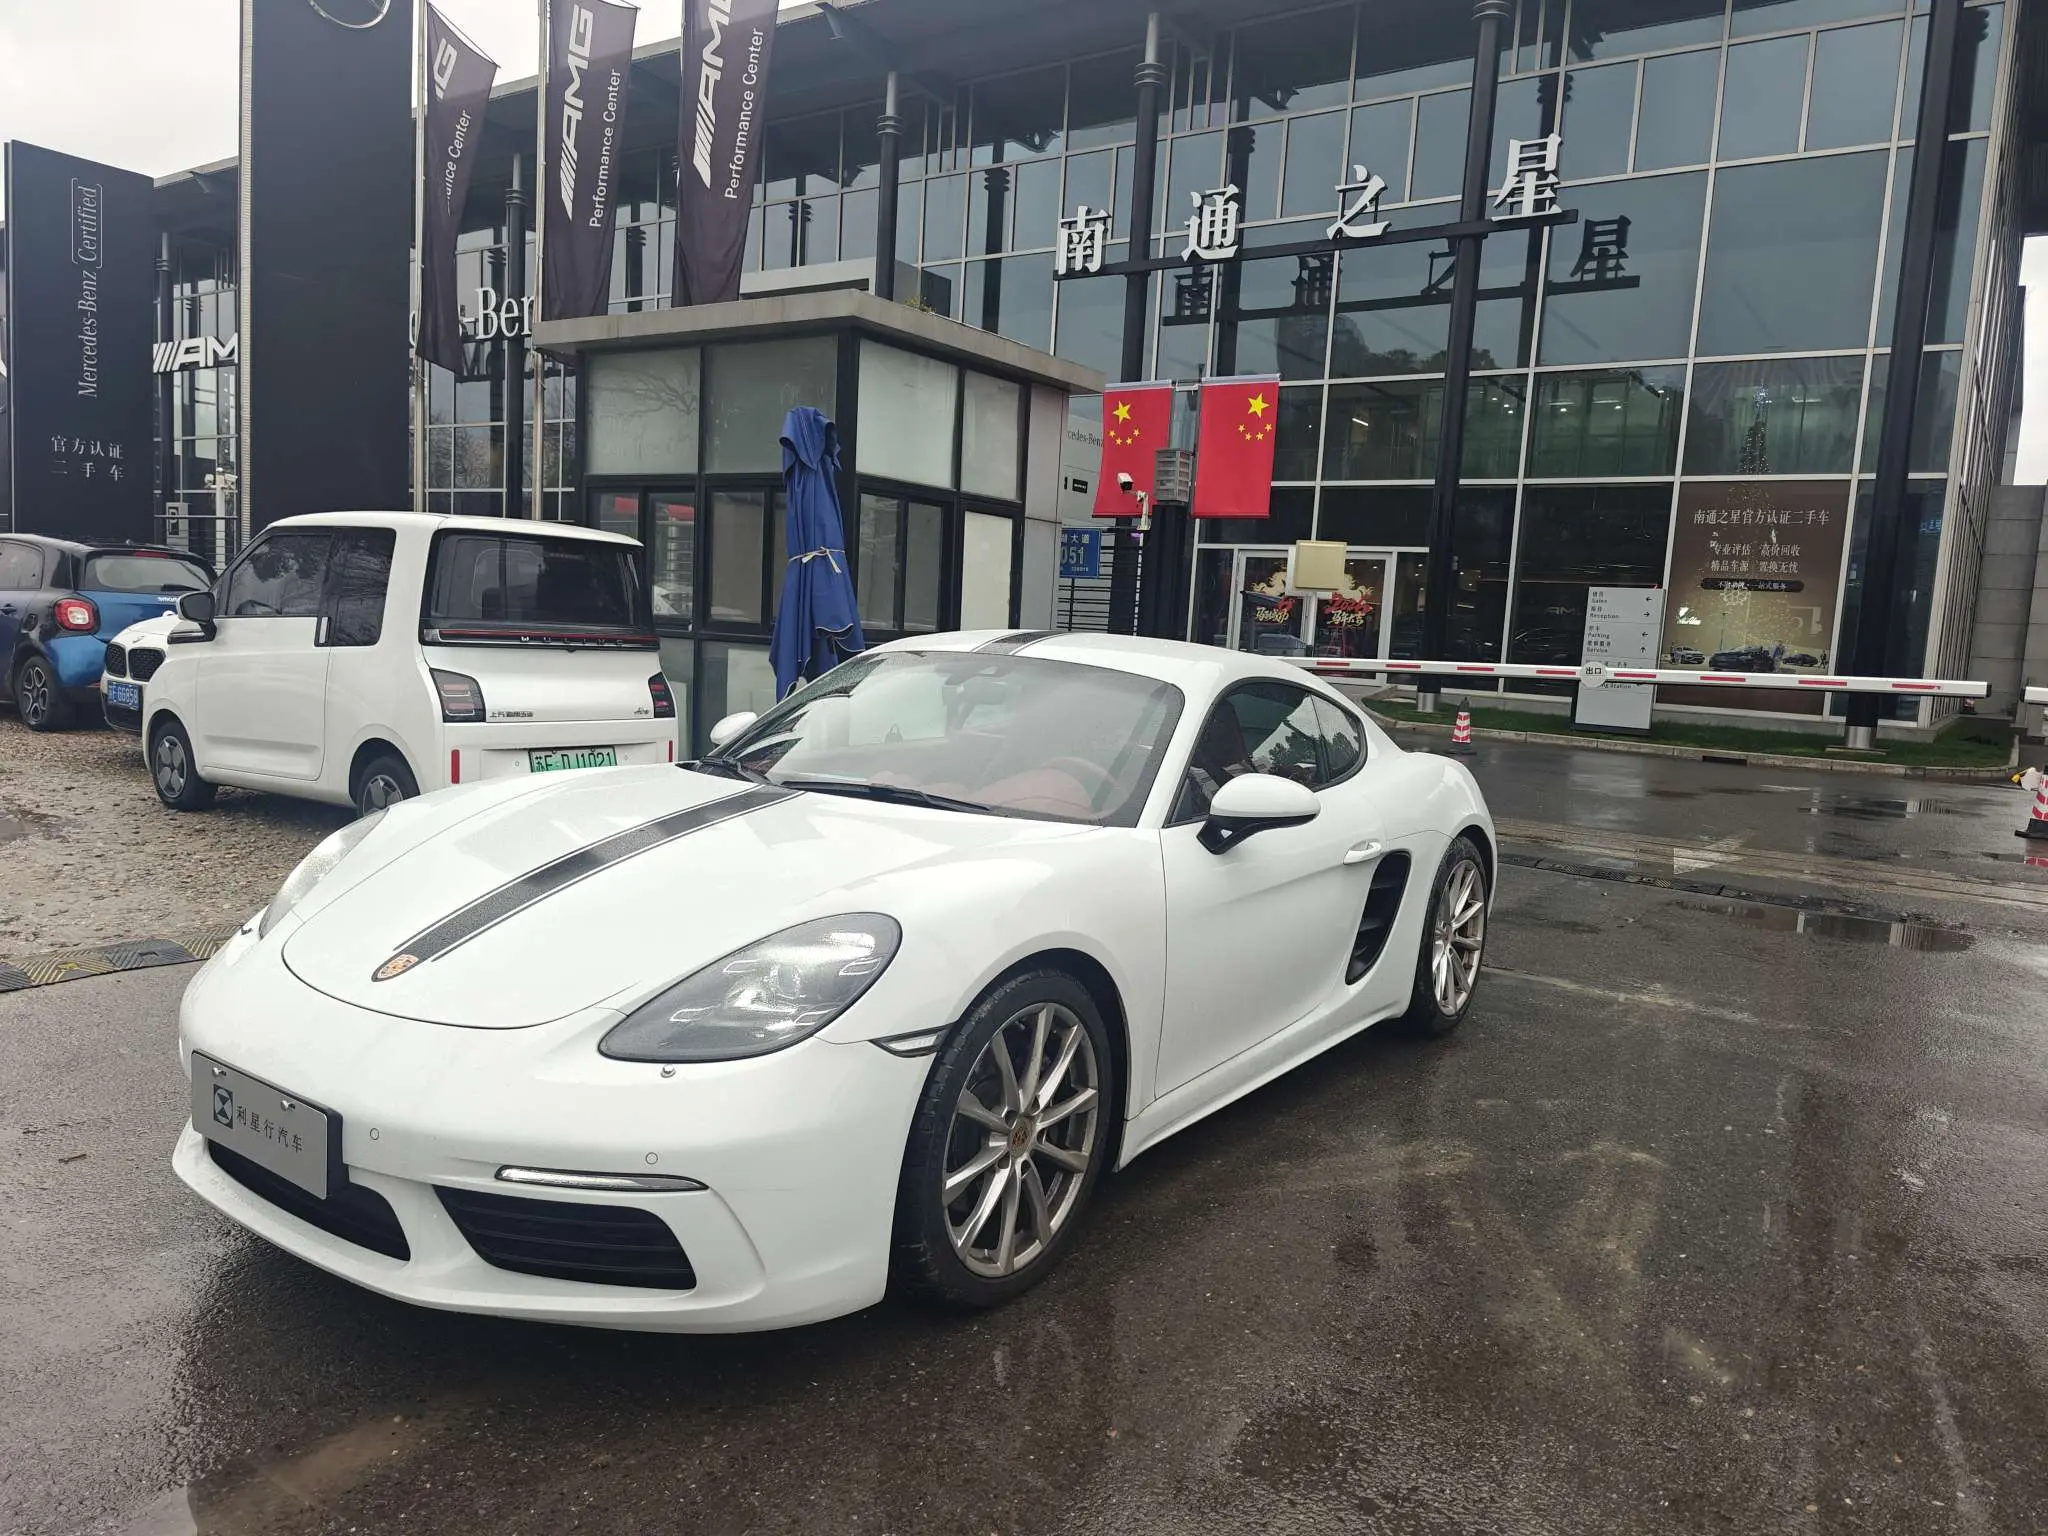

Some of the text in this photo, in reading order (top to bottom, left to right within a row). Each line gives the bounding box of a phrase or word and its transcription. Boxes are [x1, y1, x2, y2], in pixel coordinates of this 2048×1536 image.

[563, 4, 593, 161] AMG
[448, 109, 471, 159] Center
[725, 28, 763, 199] Performance Center
[590, 69, 620, 227] Performance Center
[1056, 132, 1563, 276] 南通之星
[77, 185, 97, 398] Mercedes-Benz Certified
[171, 333, 238, 372] AM
[51, 435, 124, 459] 官方认证
[52, 460, 125, 481] 二手车
[1693, 508, 1830, 525] 南通之星官方认证二手车
[1585, 667, 1602, 675] 出口
[235, 1105, 303, 1153] 利星行汽车
